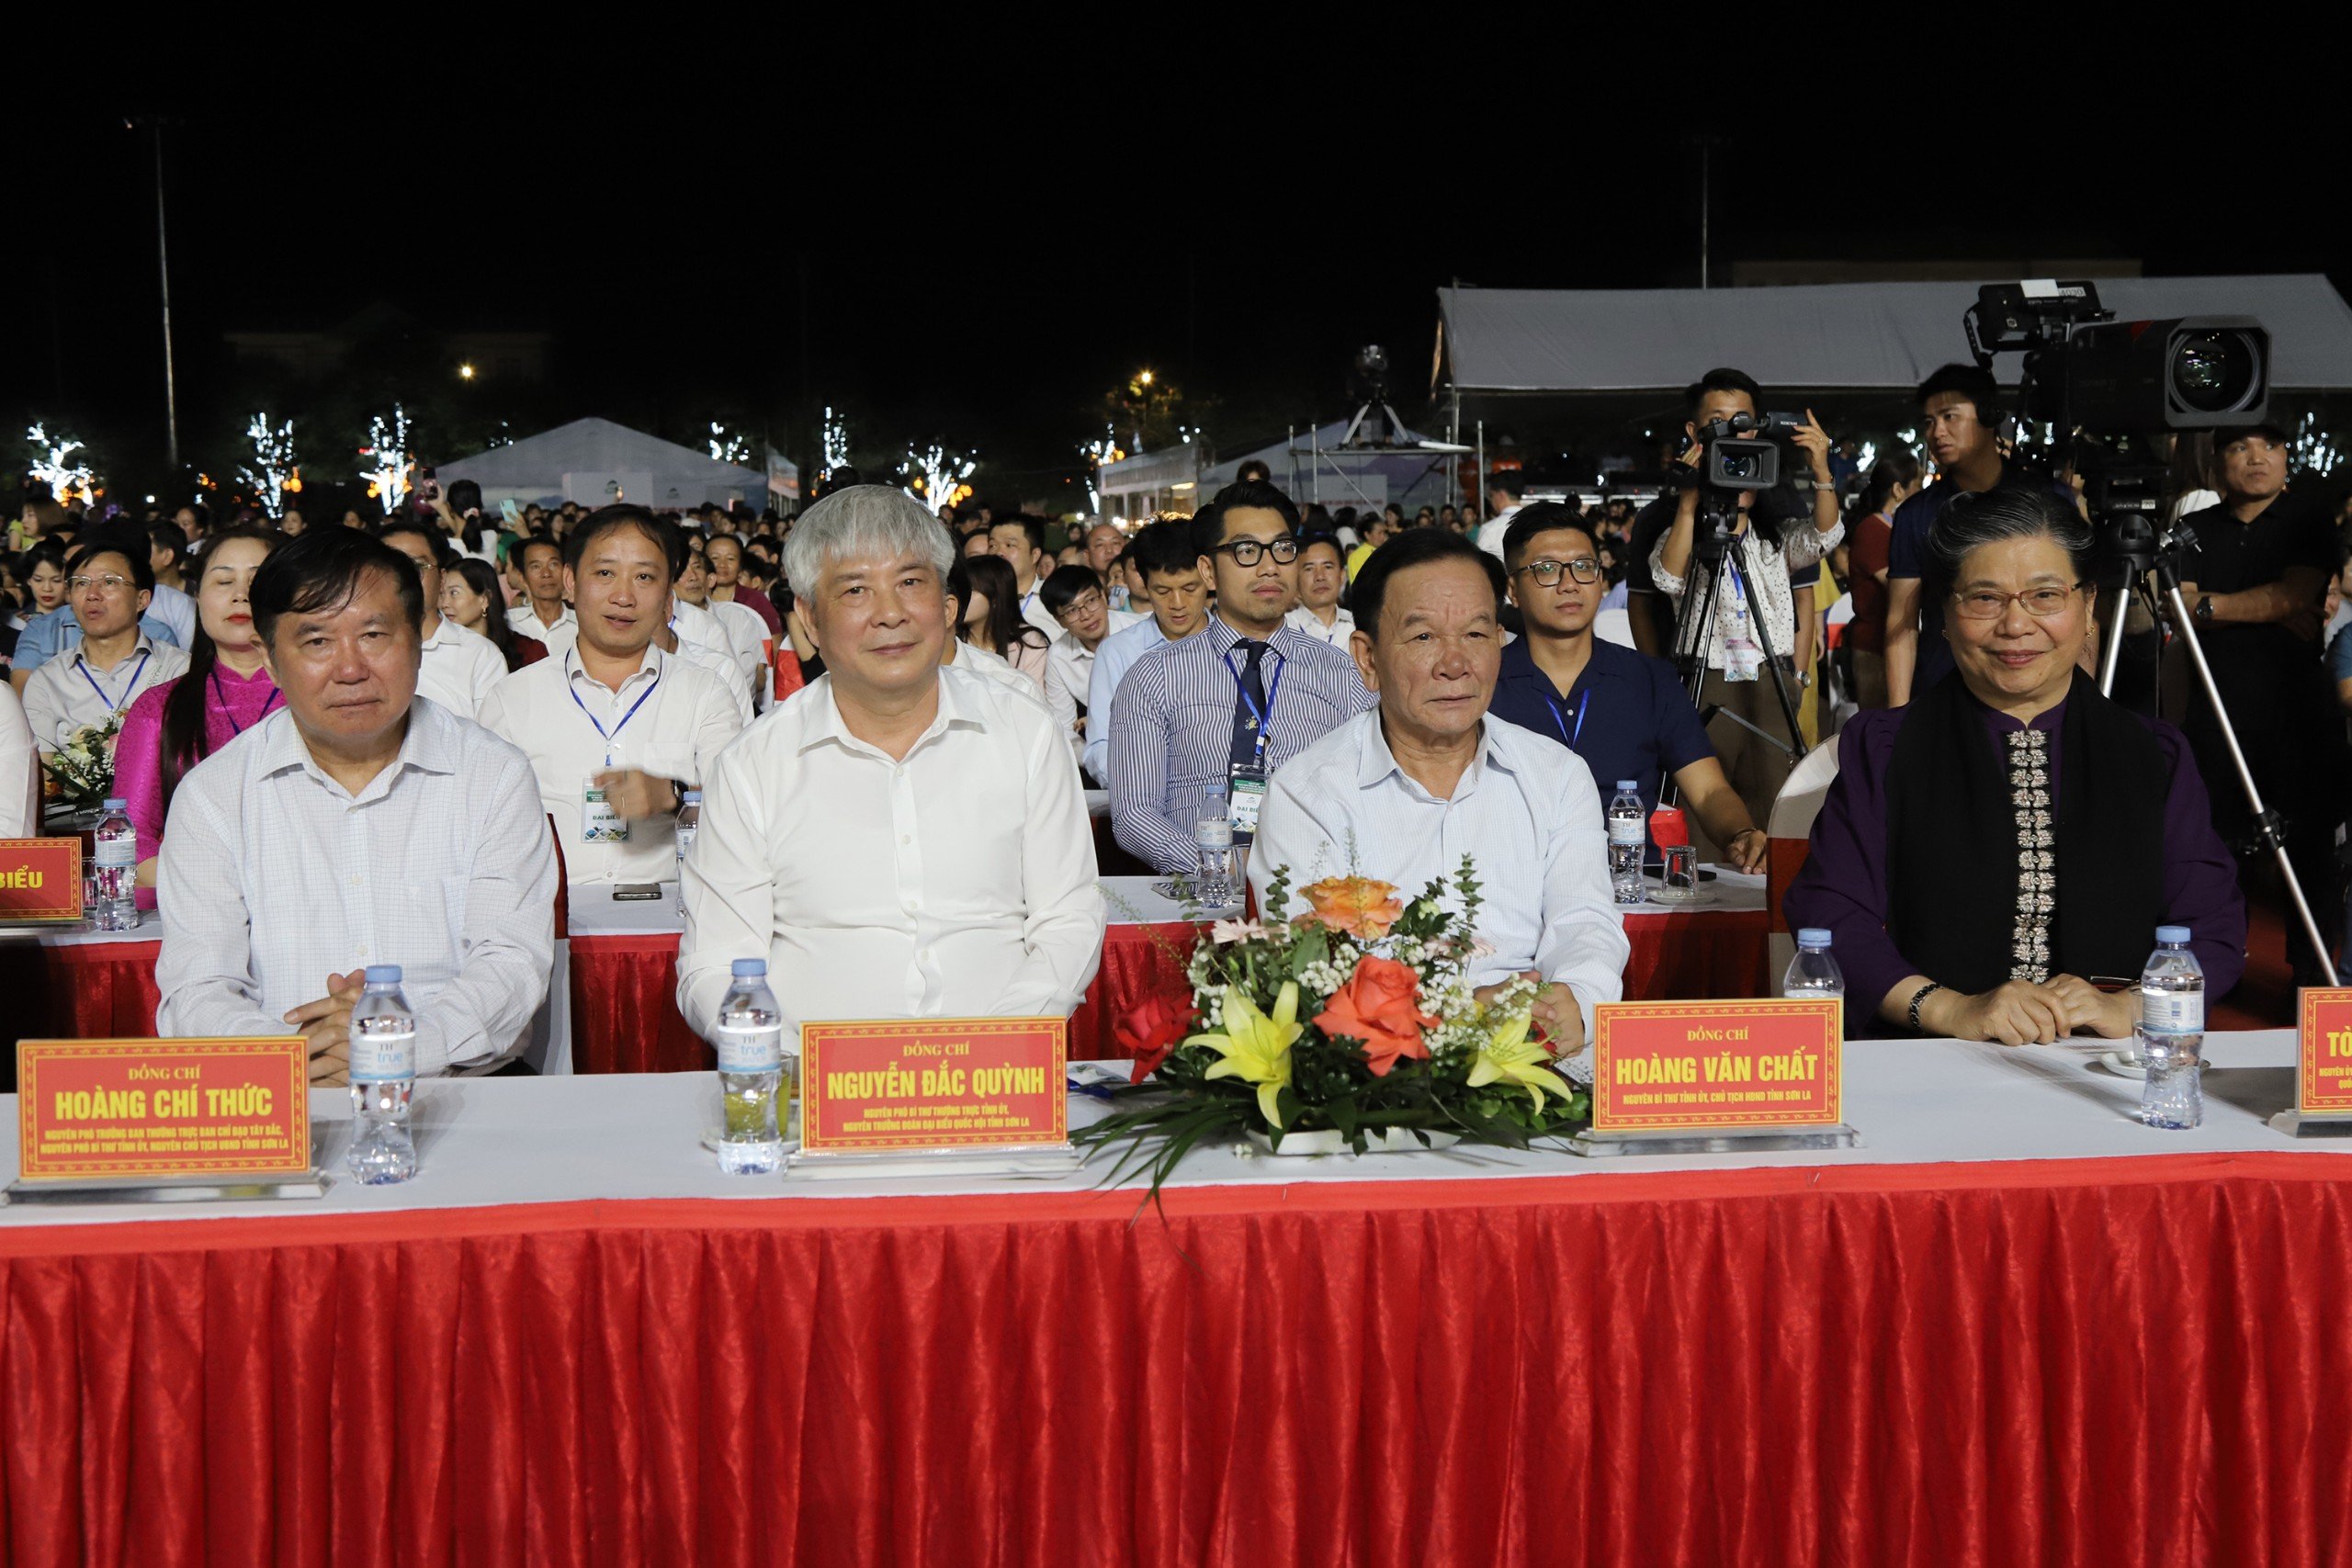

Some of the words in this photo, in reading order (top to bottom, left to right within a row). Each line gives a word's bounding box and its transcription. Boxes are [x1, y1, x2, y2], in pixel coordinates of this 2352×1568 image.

[1687, 1025, 1724, 1042] ĐỒNG
[1726, 1026, 1749, 1041] CHÍ
[741, 1044, 765, 1055] true
[903, 1040, 942, 1056] ĐỒNG
[945, 1040, 970, 1055] CHÍ
[378, 1053, 402, 1063] true
[1616, 1053, 1697, 1085] HOÀNG
[1703, 1051, 1752, 1083] VĂN
[1758, 1045, 1818, 1081] CHẤT
[128, 1063, 170, 1080] ĐỒNG
[174, 1064, 200, 1079] CHÍ
[828, 1061, 916, 1100] NGUYỄN
[922, 1060, 966, 1098] ĐẮC
[972, 1063, 1045, 1099] QUỲNH
[55, 1085, 146, 1121] HOÀNG
[153, 1084, 198, 1118] CHÍ
[206, 1082, 273, 1117] THỨC
[1623, 1092, 1654, 1105] NGUYÊN
[1654, 1091, 1663, 1104] BÍ
[1664, 1092, 1679, 1104] THƯ
[1679, 1090, 1697, 1103] TỈNH
[1711, 1089, 1726, 1102] CHỦ
[1727, 1091, 1744, 1104] TỊCH
[1766, 1088, 1784, 1100] TỈNH
[1785, 1089, 1801, 1100] SƠN
[1802, 1089, 1812, 1100] LA
[864, 1106, 893, 1119] NGUYÊN
[45, 1128, 77, 1140] NGUYÊN
[249, 1124, 264, 1136] TÂY
[843, 1120, 872, 1132] NGUYÊN
[1021, 1117, 1030, 1127] LA
[278, 1139, 289, 1150] LA
